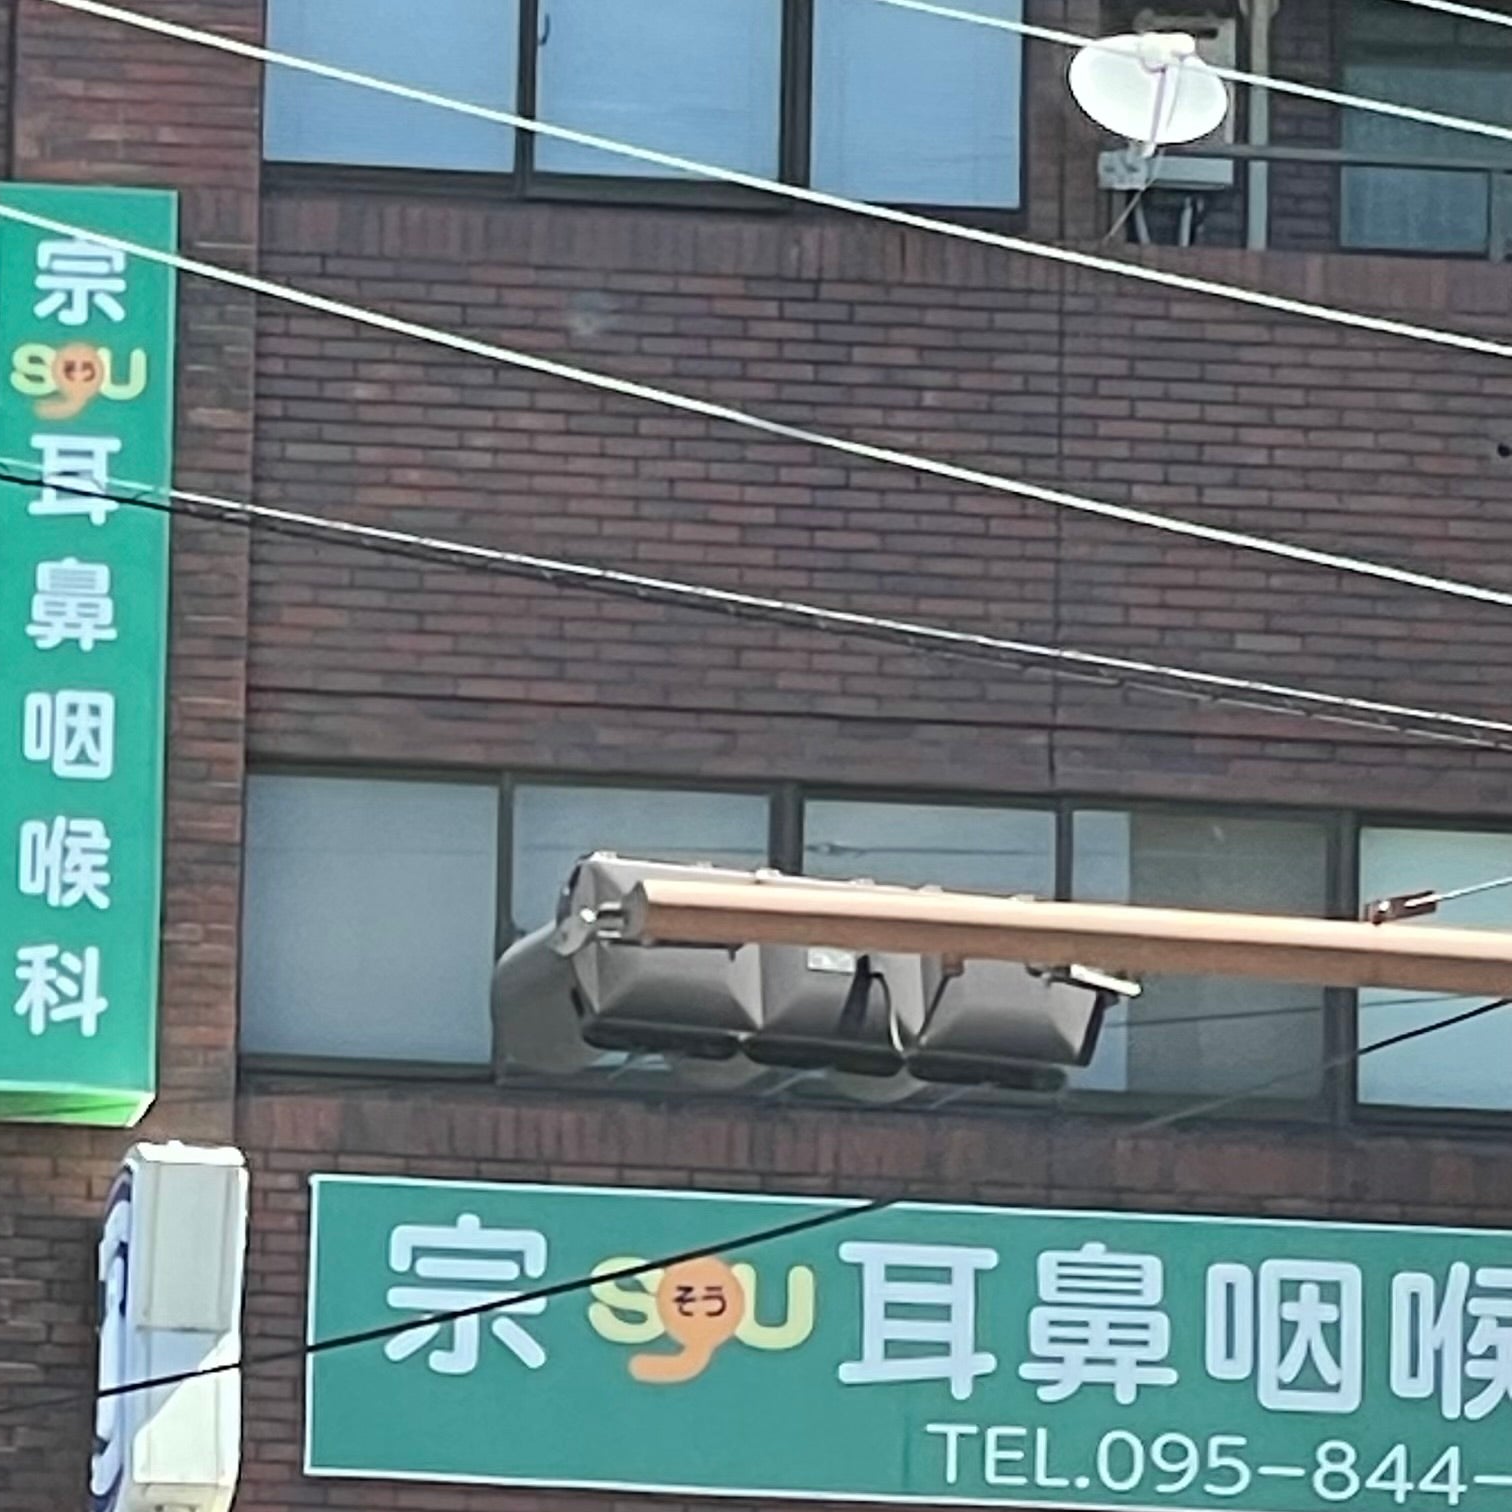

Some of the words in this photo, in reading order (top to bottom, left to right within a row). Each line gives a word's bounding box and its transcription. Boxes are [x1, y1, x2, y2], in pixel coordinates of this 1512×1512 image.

[33, 236, 127, 326] 宗
[13, 433, 123, 1038] 耳鼻咽喉科
[384, 1212, 548, 1376] 宗
[836, 1240, 1512, 1421] 耳鼻咽喉
[672, 1284, 728, 1318] そう
